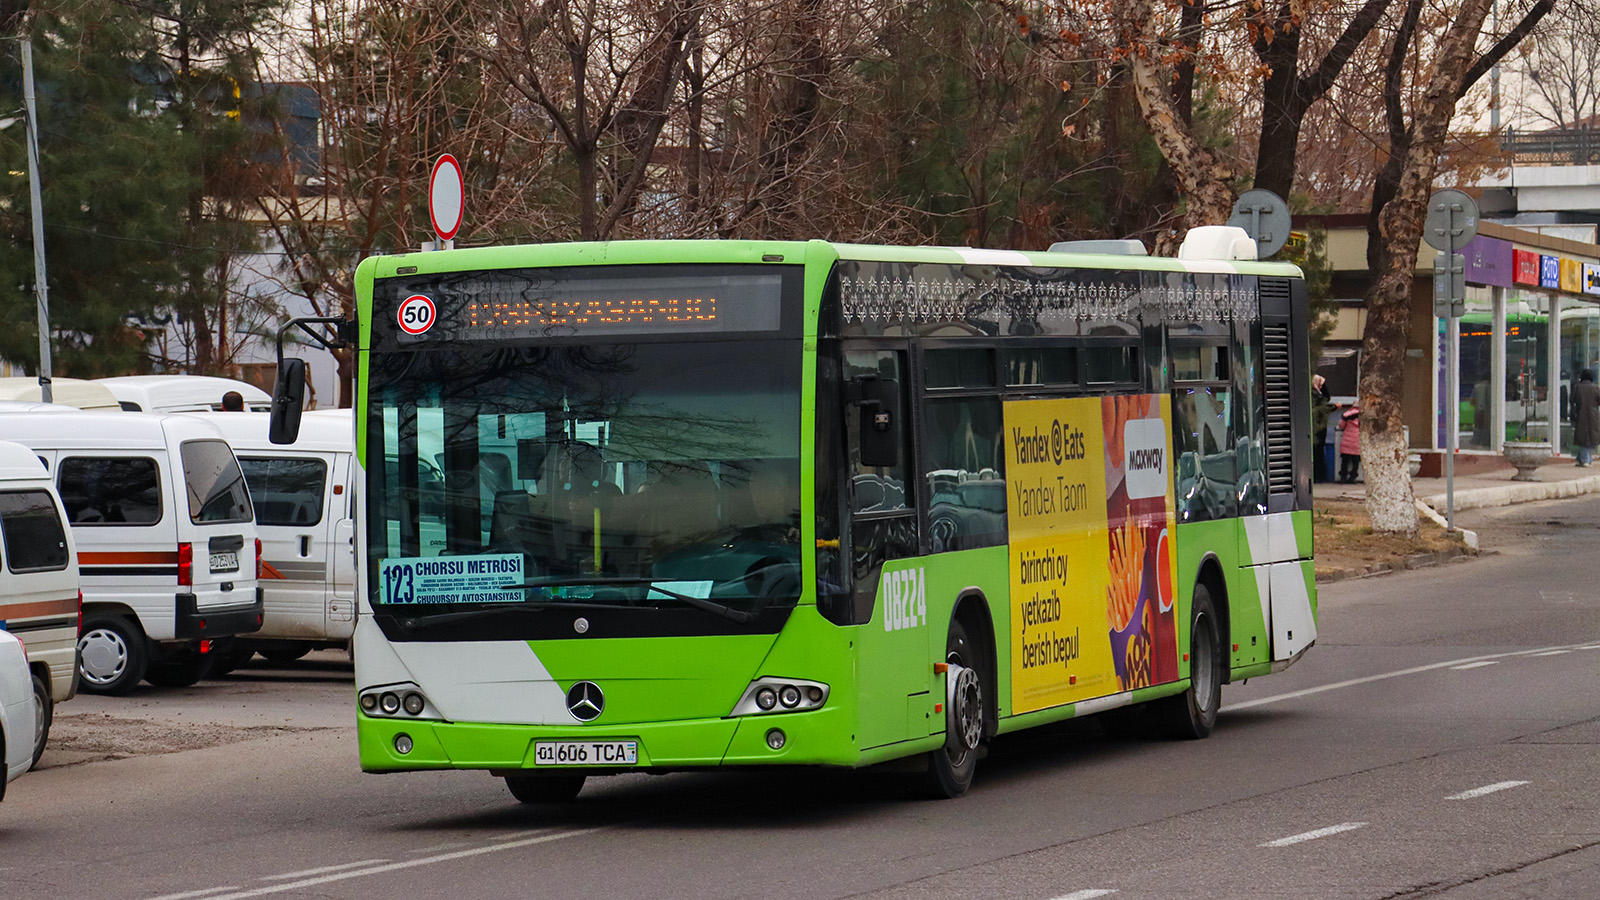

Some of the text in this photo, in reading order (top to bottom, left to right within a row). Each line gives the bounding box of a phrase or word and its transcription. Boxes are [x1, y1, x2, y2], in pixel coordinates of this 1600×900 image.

[404, 305, 429, 324] 50
[1013, 424, 1085, 464] Yandex Eats
[1015, 476, 1088, 517] Yandex Taom
[383, 565, 414, 604] 123
[415, 561, 464, 576] CHORSU
[1020, 548, 1068, 586] birinchi oy
[883, 567, 927, 632] 08224
[1021, 589, 1061, 635] yetkazib
[1022, 627, 1080, 669] berish bepul
[539, 747, 554, 760] 01
[557, 745, 588, 761] 606
[593, 744, 626, 761] TCA
